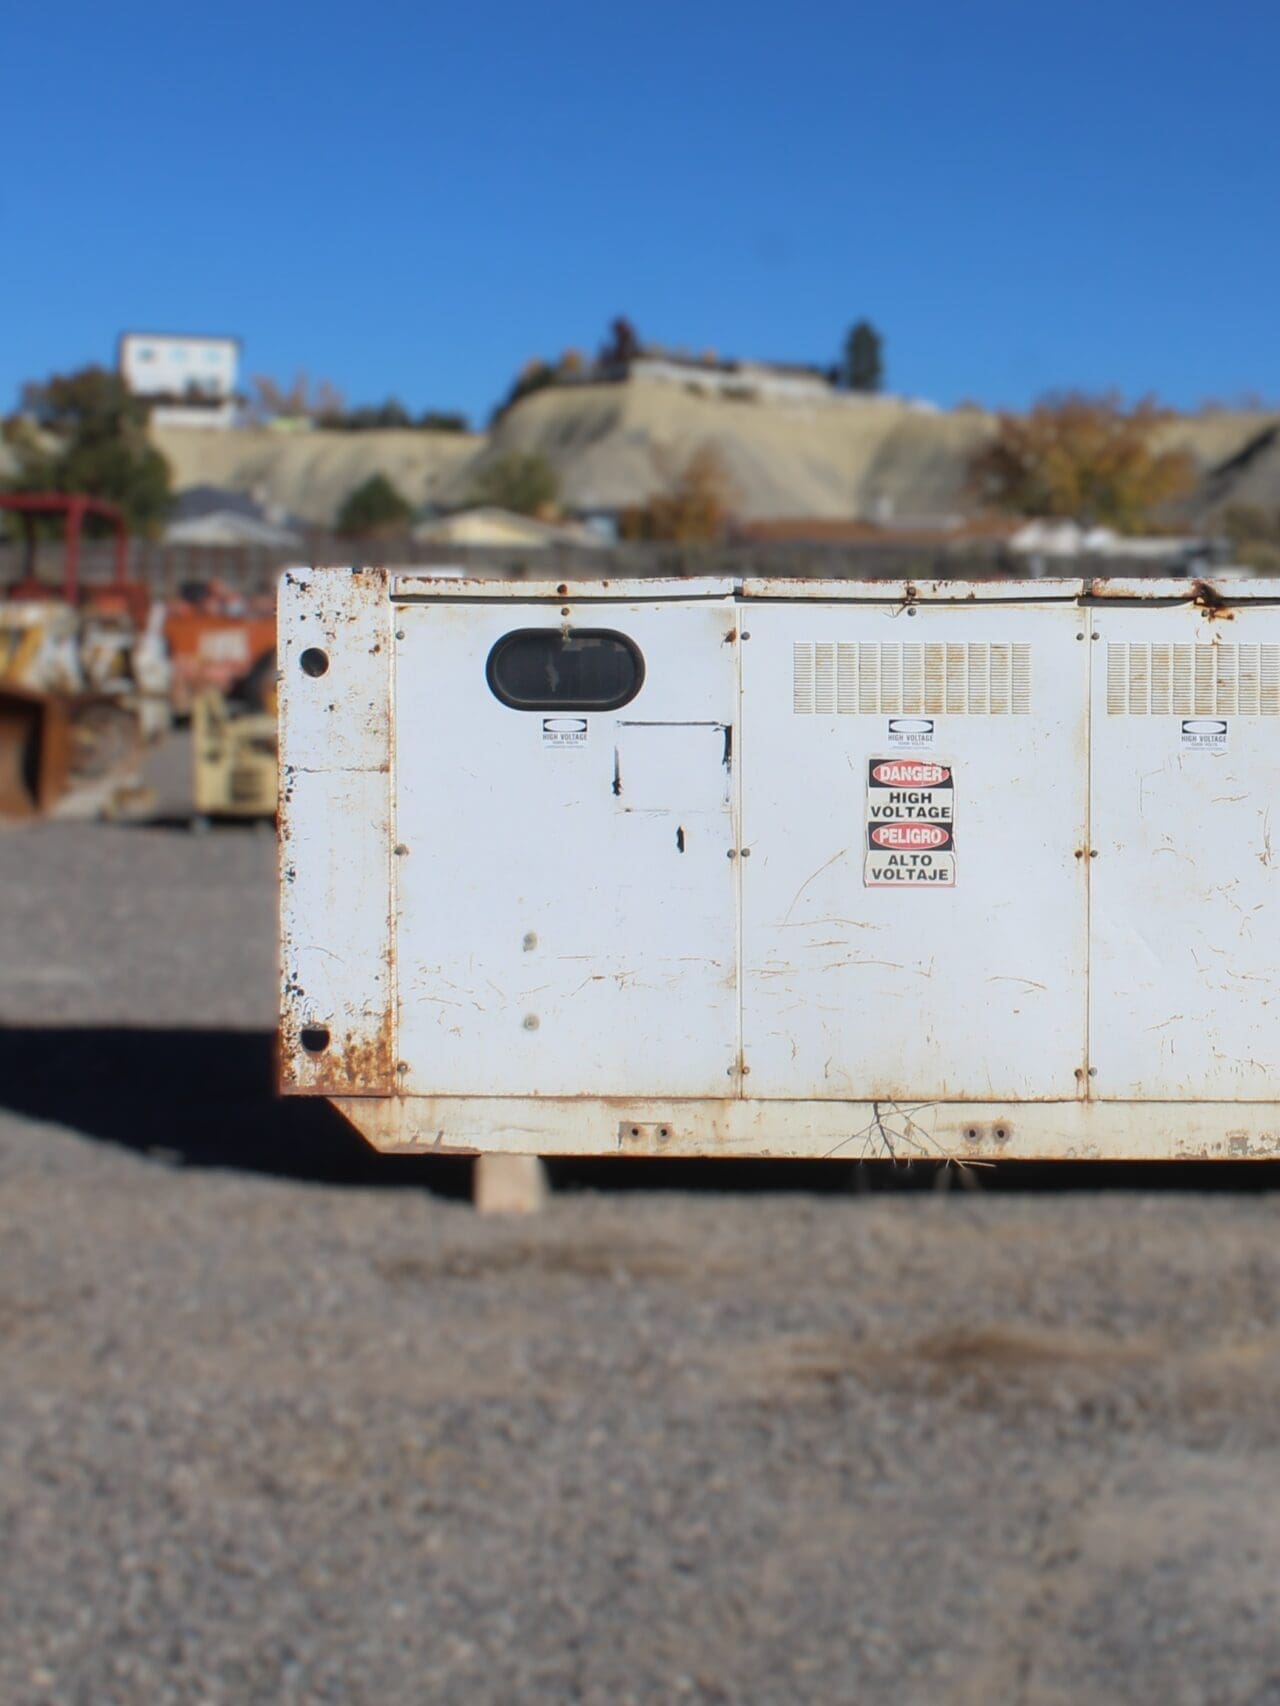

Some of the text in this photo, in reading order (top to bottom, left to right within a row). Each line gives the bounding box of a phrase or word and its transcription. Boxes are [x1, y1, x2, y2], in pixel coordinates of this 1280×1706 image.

[906, 734, 933, 742] VOLTAGE
[1200, 735, 1226, 743] VOLTAGE
[880, 765, 943, 782] DANGER
[889, 792, 933, 804] HIGH
[871, 806, 951, 819] VOLTAGE
[880, 828, 941, 844] PELIGRO
[888, 855, 933, 866] ALTO
[872, 869, 949, 881] VOLTAJE
